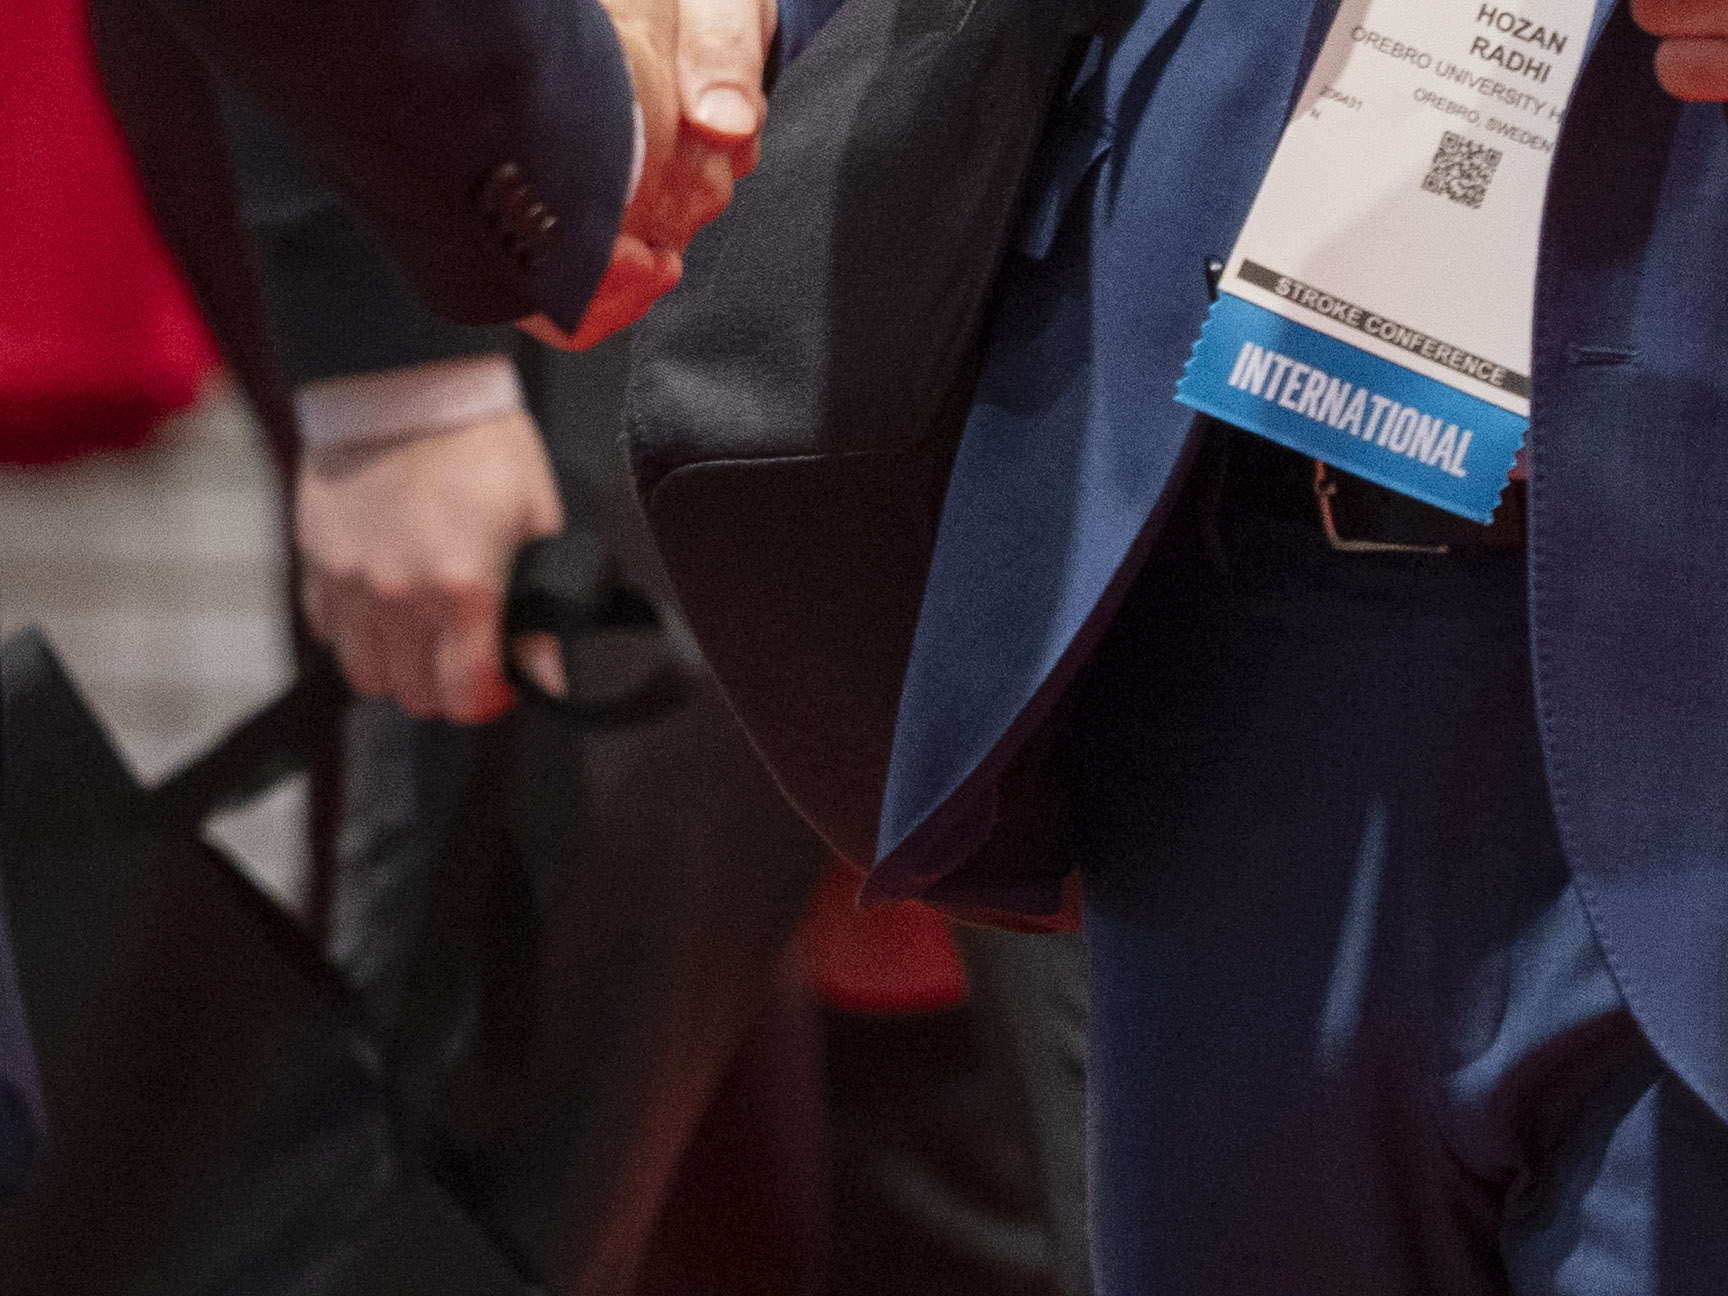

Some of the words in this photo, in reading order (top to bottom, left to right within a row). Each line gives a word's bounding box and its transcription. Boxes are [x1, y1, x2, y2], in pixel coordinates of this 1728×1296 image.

[1470, 36, 1553, 84] RADHI
[1476, 3, 1569, 56] HOZAN
[1351, 25, 1433, 70] OREBRO
[1434, 60, 1547, 116] UNIVERSITY
[1484, 116, 1555, 154] SWEDEN
[1273, 275, 1361, 327] STROKE
[1363, 312, 1506, 388] CONFERENCE
[1227, 341, 1473, 479] INTERNATIONAL
